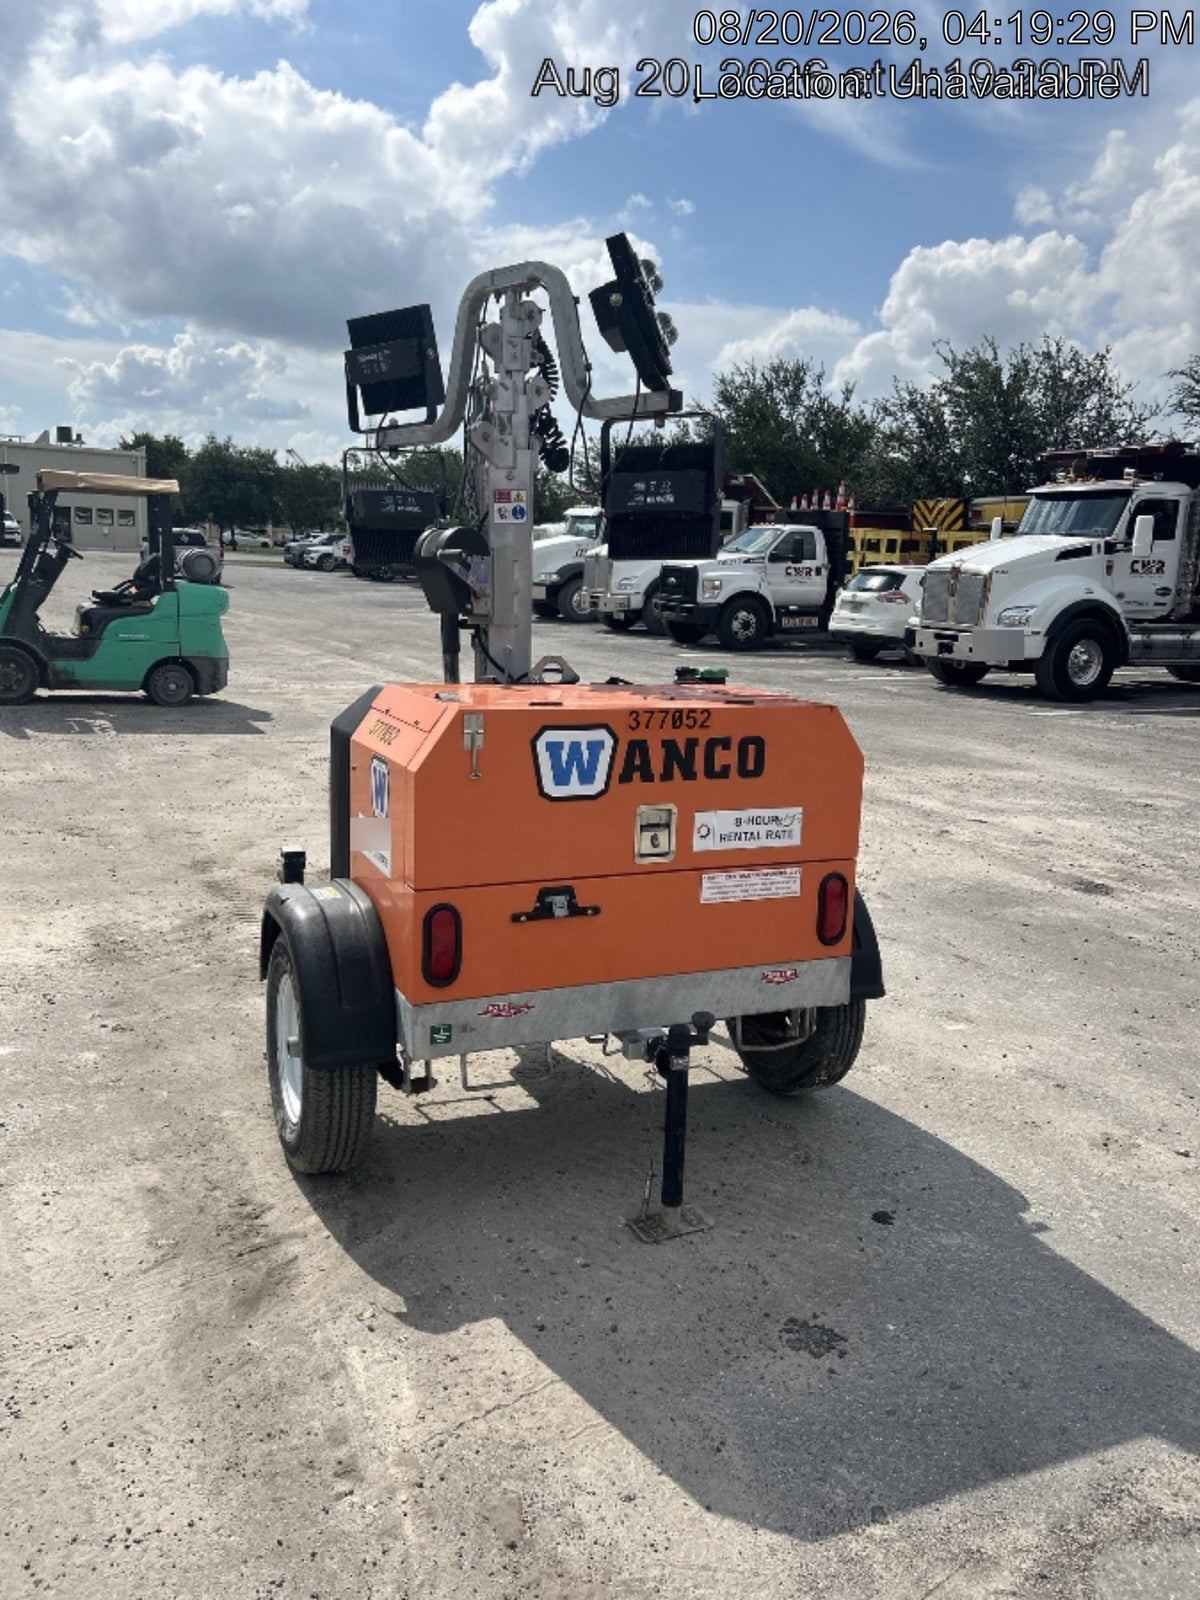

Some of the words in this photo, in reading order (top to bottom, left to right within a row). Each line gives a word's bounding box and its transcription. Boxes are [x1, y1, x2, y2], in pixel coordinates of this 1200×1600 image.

[628, 709, 712, 731] 377052
[540, 732, 765, 790] WANCO
[719, 831, 760, 843] RENTAL
